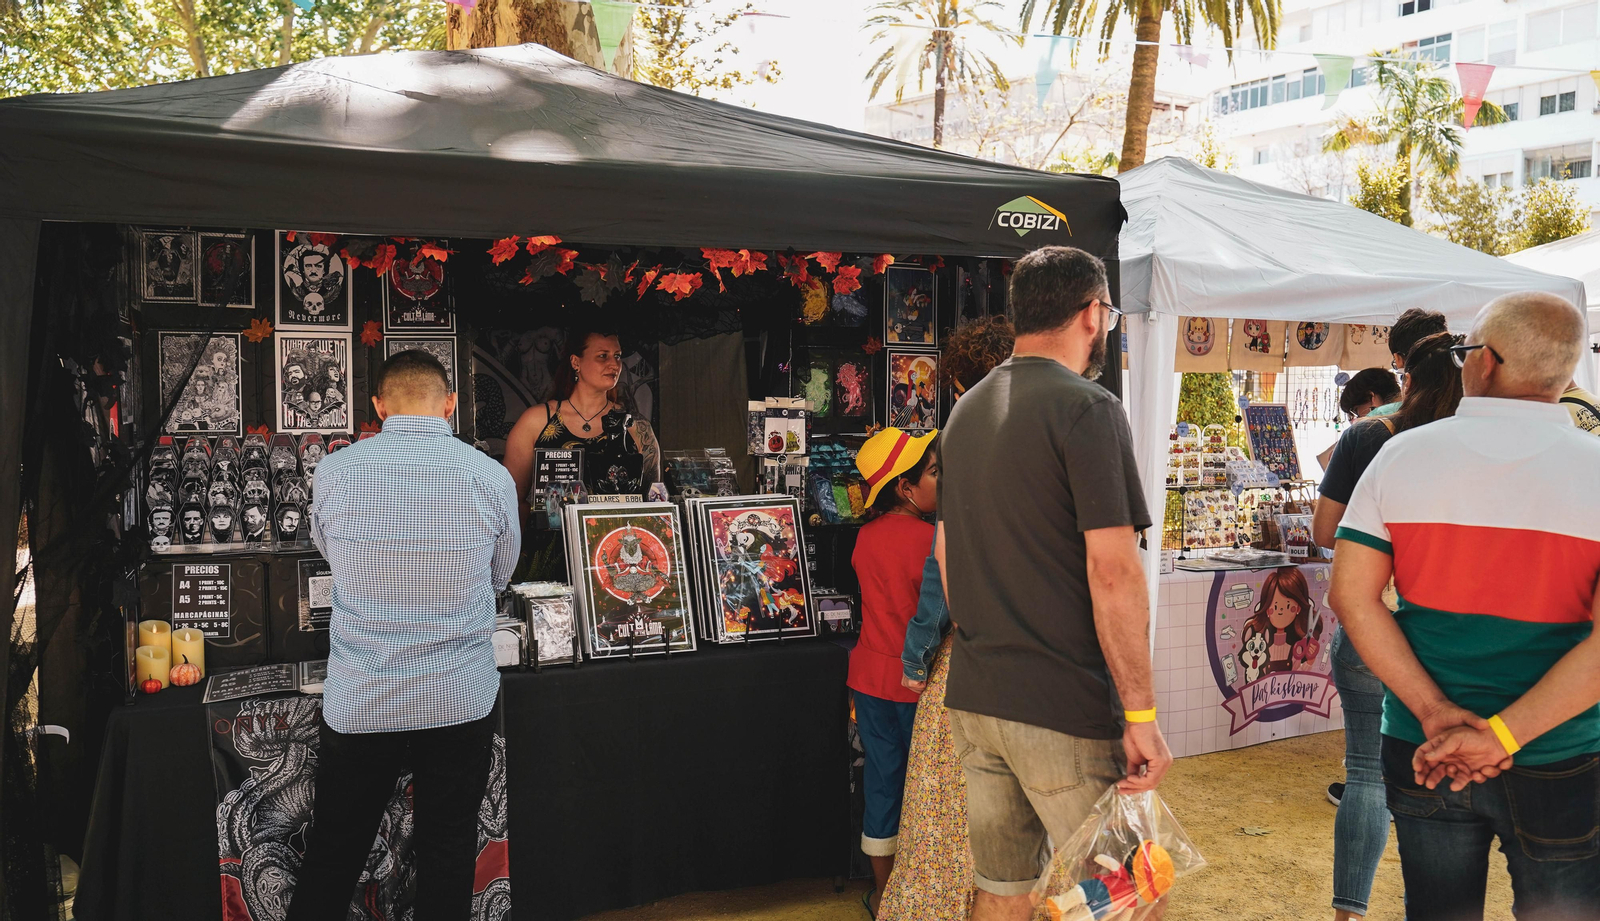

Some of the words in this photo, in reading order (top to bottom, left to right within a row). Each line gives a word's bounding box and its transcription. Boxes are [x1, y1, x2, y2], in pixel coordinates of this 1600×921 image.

[997, 211, 1060, 231] COBIZI
[288, 309, 341, 323] Nevermore
[318, 340, 334, 354] WE
[334, 340, 346, 374] DO
[283, 403, 295, 428] IN
[295, 411, 311, 428] THE
[545, 451, 572, 459] PRECIOS
[540, 463, 550, 471] A4
[588, 495, 620, 503] COLLARES
[184, 565, 220, 575] PRECIOS
[179, 580, 191, 589] A4
[179, 595, 191, 604] A5
[174, 611, 229, 619] MARCAPÁGINAS
[230, 665, 278, 677] PRECIOS
[214, 710, 290, 735] ONYX
